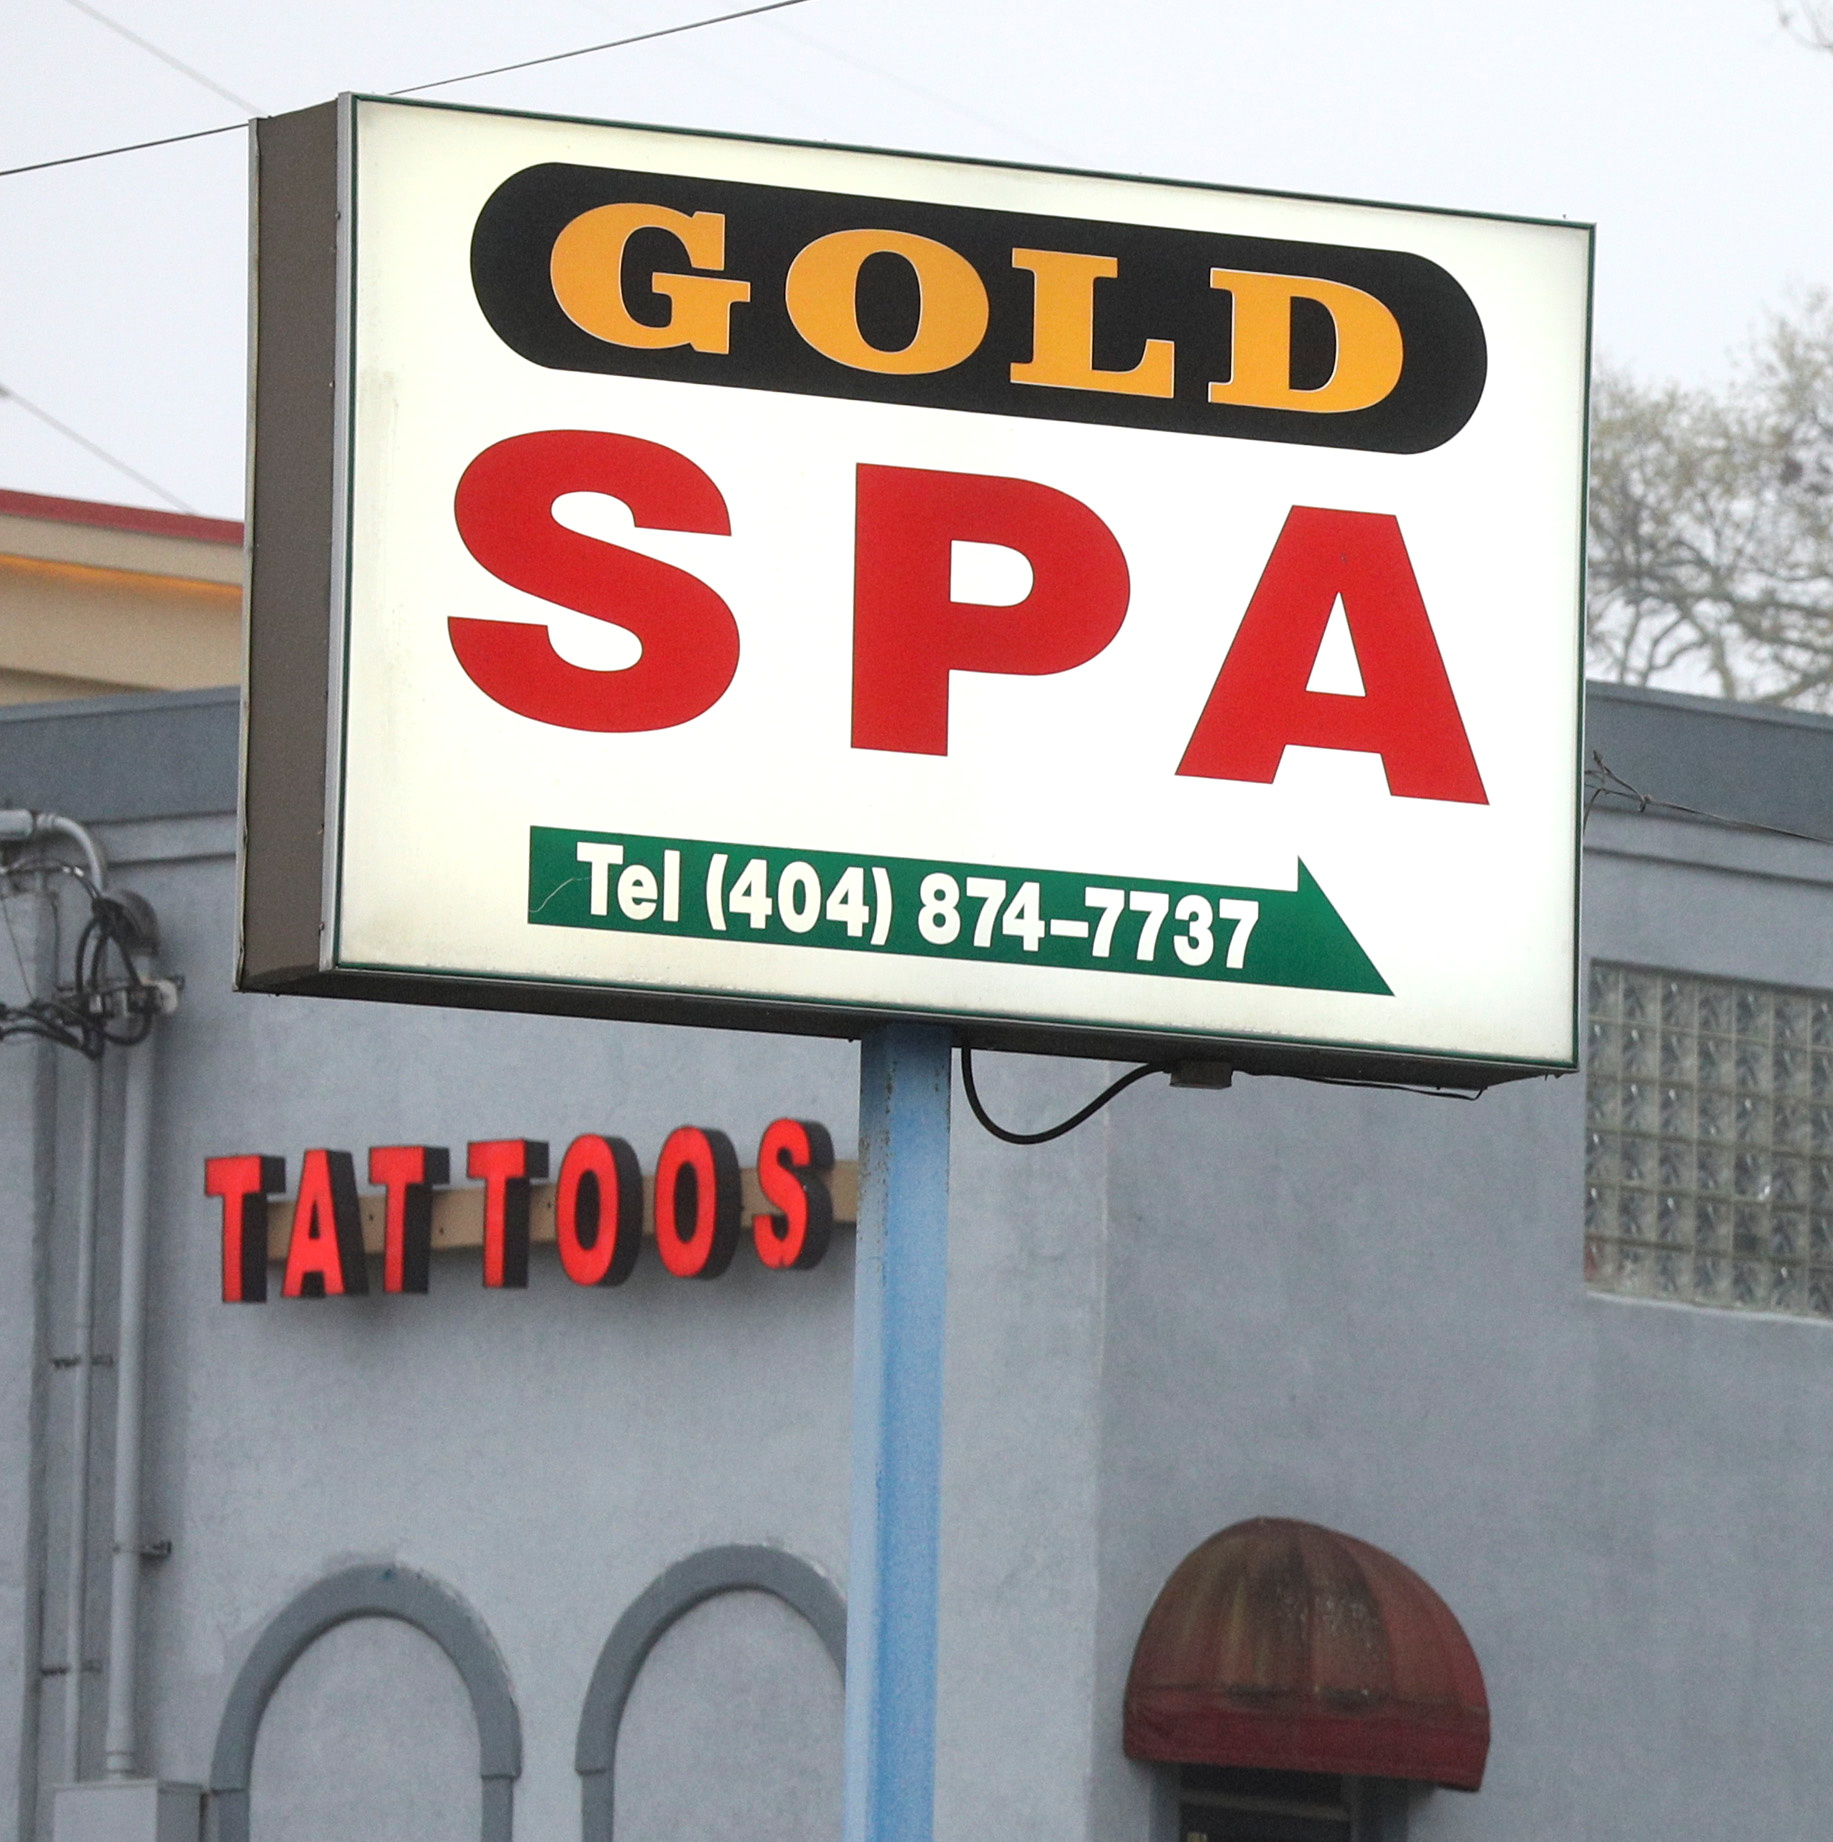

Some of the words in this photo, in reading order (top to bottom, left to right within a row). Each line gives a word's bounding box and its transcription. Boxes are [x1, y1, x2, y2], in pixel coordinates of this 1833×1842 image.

[550, 202, 1404, 413] GOLD
[447, 428, 1490, 806] SPA
[576, 841, 680, 922] Tel
[705, 852, 894, 946] (404)
[917, 872, 1260, 970] 874-7737
[204, 1117, 834, 1304] TATTOOS
